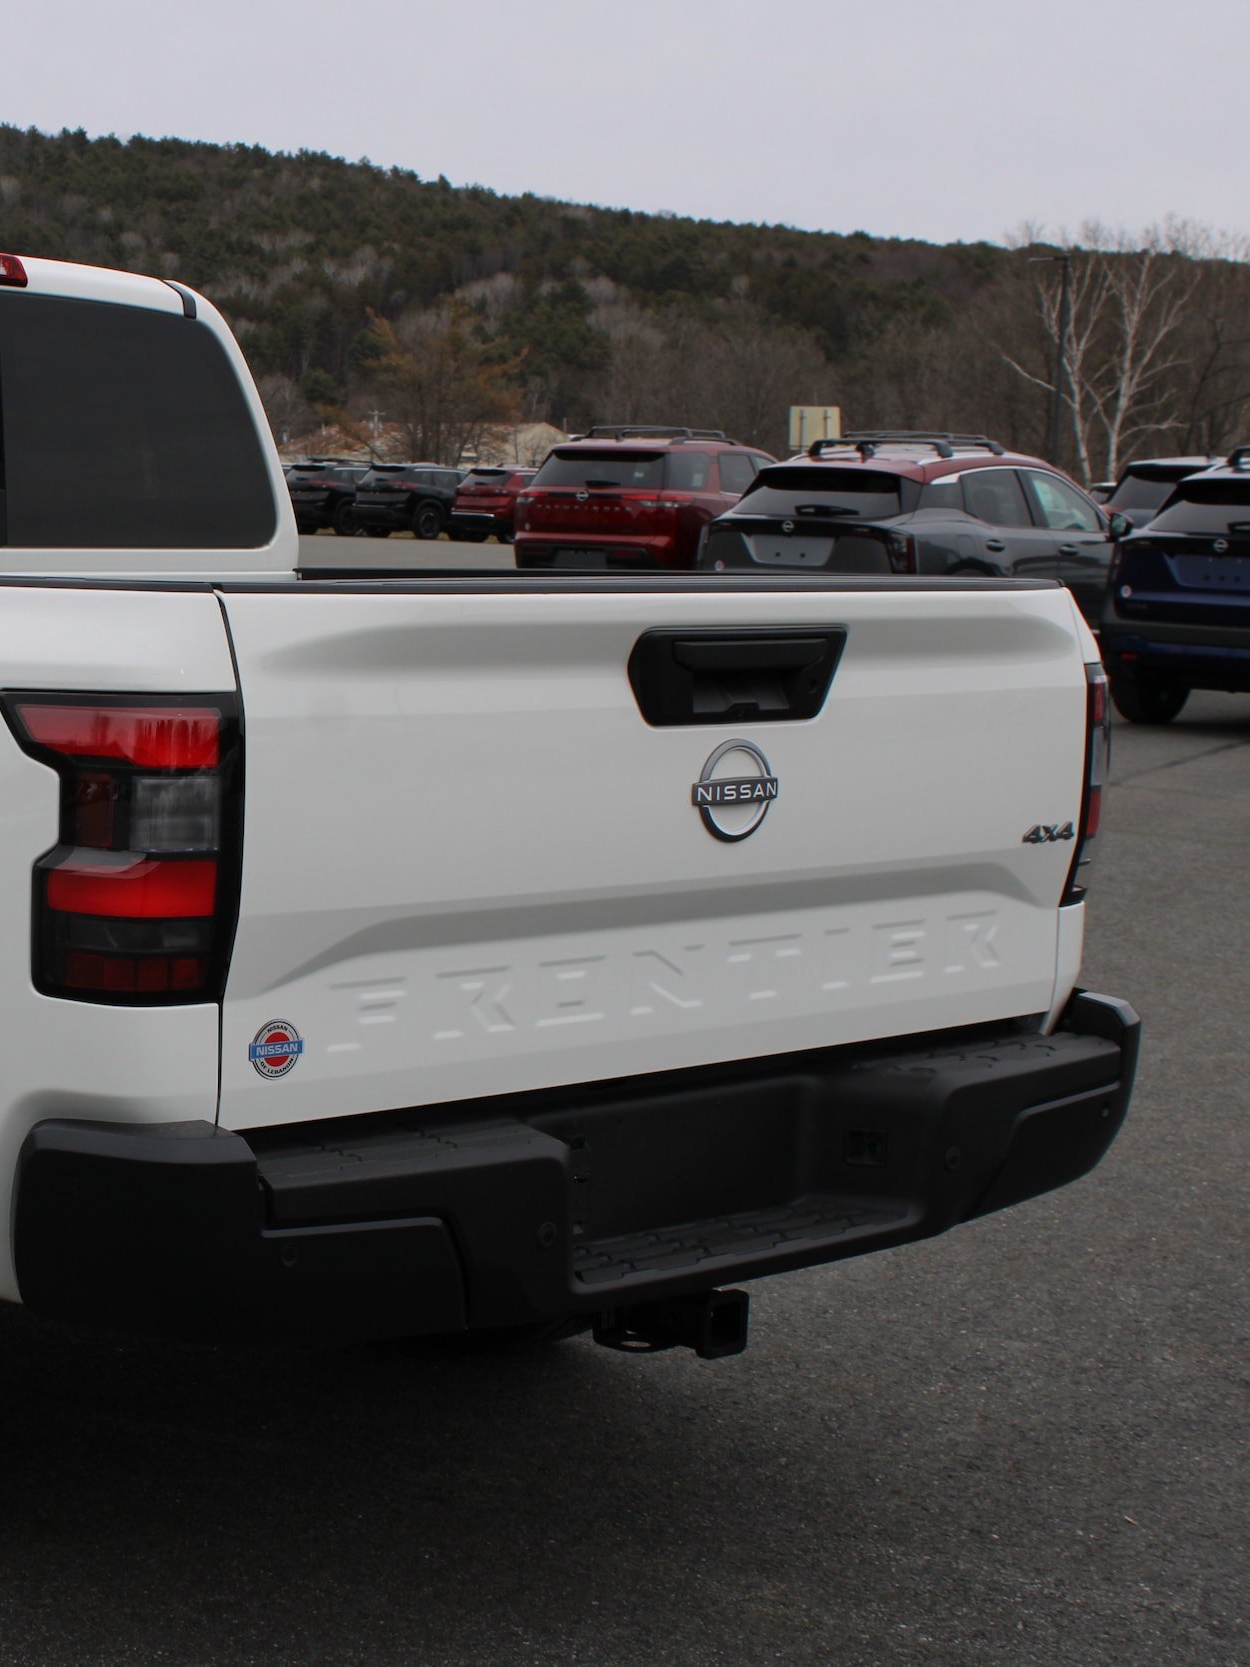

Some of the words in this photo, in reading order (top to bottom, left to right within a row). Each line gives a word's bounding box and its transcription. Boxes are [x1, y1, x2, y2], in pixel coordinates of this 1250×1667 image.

[697, 781, 777, 802] NISSAN
[326, 909, 1000, 1052] FRONTIER
[268, 1024, 288, 1032] NISSAN
[257, 1044, 298, 1056] NISSAN
[268, 1058, 294, 1074] LEBANON
